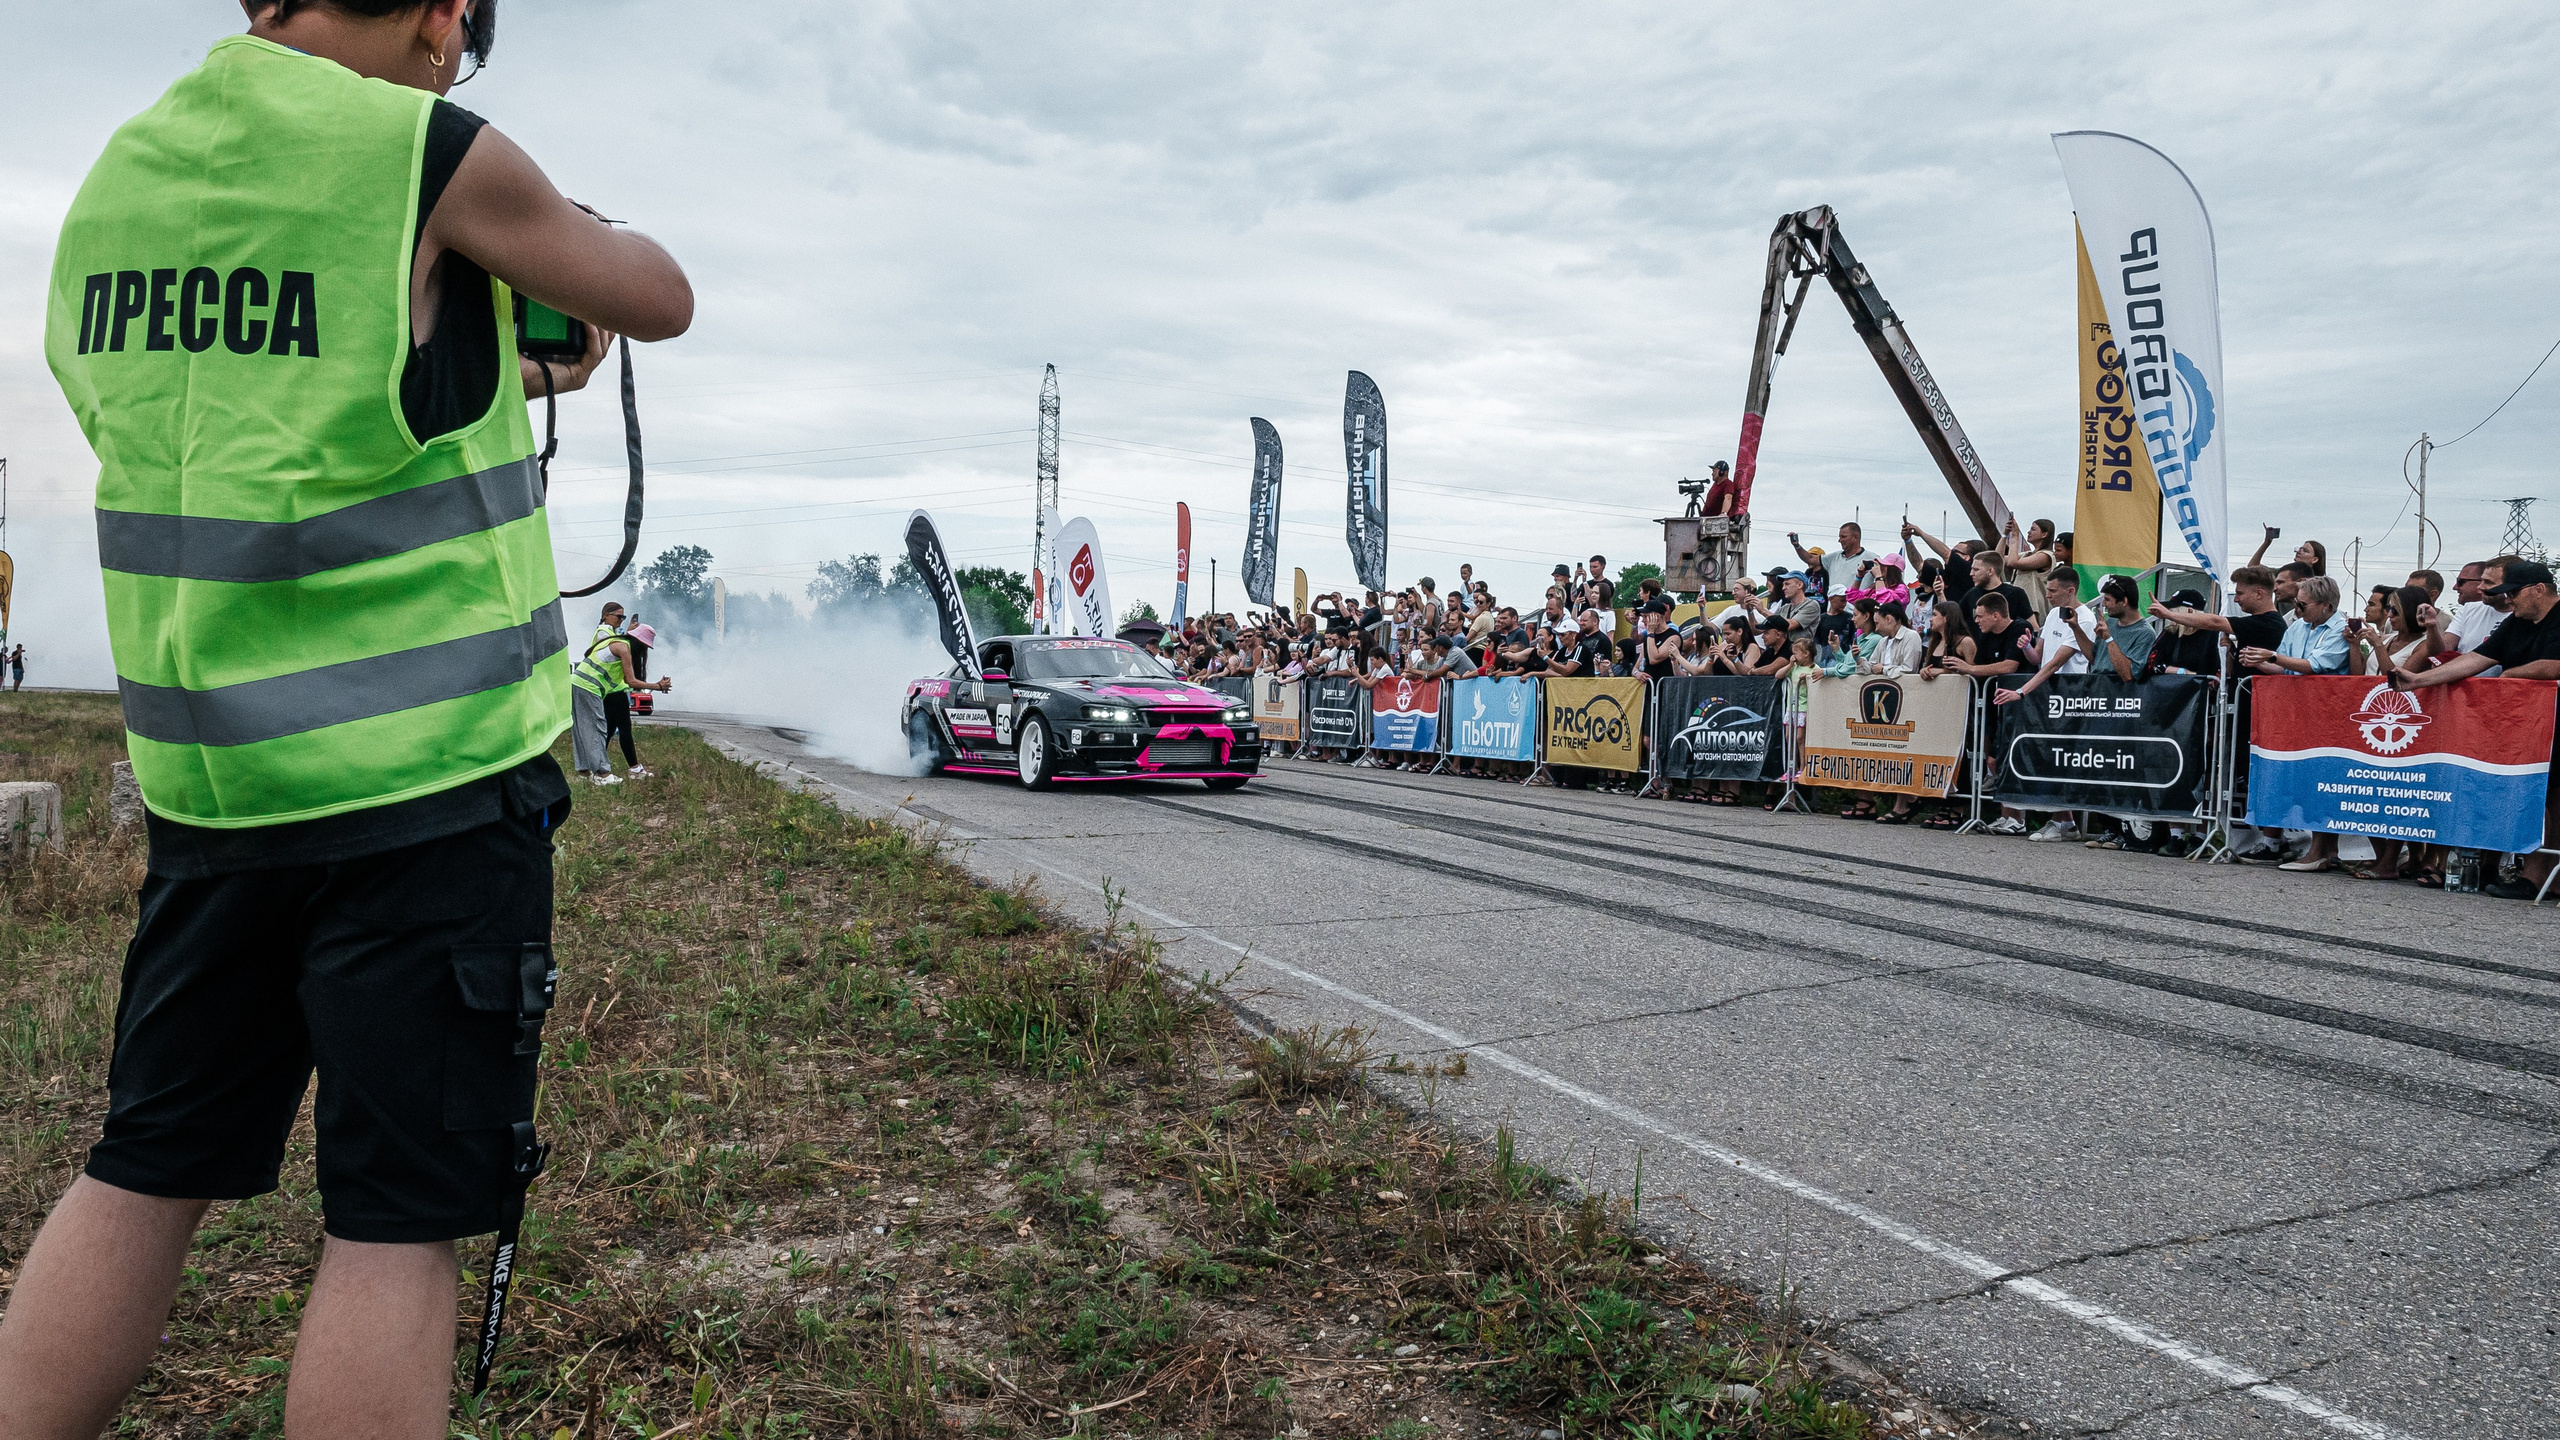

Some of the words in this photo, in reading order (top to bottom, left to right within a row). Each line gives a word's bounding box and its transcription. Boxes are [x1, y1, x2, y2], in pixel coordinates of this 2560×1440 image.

[78, 266, 320, 358] ПРЕССА
[1909, 357, 1953, 430] 57-58-59
[2065, 696, 2107, 710] ДАЙТЕ
[2115, 698, 2141, 710] ДВА
[950, 713, 965, 721] MADE
[965, 713, 971, 721] IN
[972, 713, 987, 721] JAPAN
[997, 714, 1011, 734] FQ
[1462, 721, 1520, 749] ПЬЮТТИ
[1551, 735, 1588, 750] EXTREME
[1692, 730, 1765, 751] AUTOBOKS
[2052, 748, 2135, 770] Trade-in
[1806, 755, 1914, 787] НЕФИЛЬТРОВАННЫЙ
[2347, 769, 2427, 783] АССОЦИАЦИЯ
[2317, 782, 2373, 796] РАЗВИТИЯ
[2340, 801, 2380, 815] ВИДОВ
[2384, 805, 2430, 818] СПОРТА
[2327, 819, 2387, 834] АМУРСКОЙ
[493, 1242, 514, 1285] NIKE
[480, 1288, 505, 1370] AIRMAX
